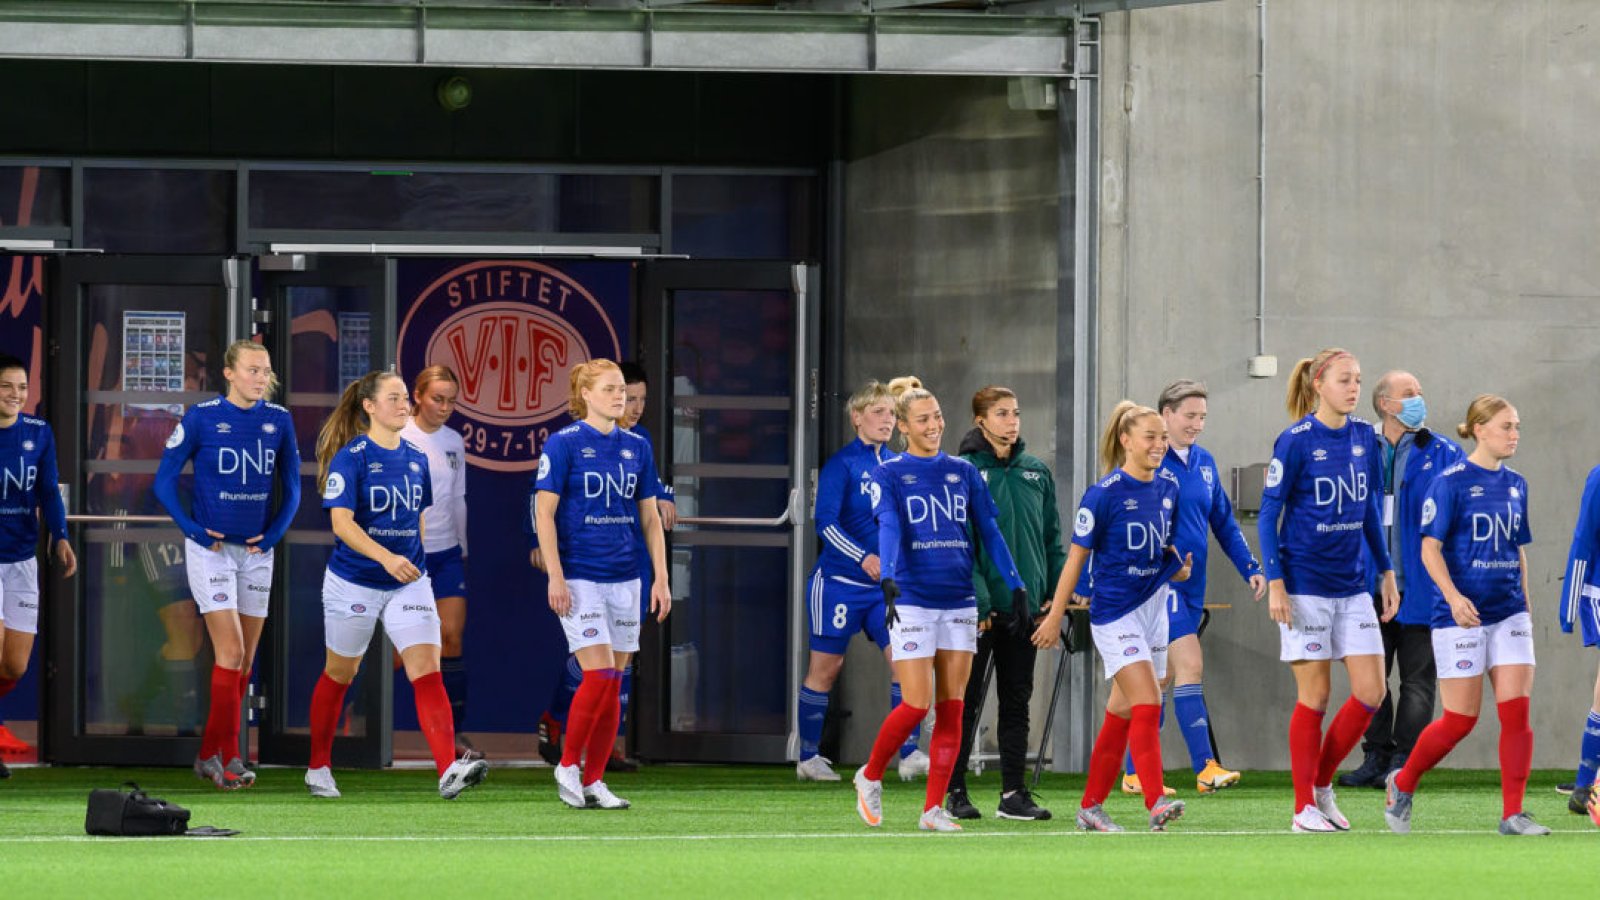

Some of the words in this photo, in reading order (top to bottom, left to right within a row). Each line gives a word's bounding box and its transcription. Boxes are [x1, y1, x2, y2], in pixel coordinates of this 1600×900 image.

[447, 270, 573, 313] STIFTET
[0, 455, 38, 500] NB
[218, 438, 276, 485] DNB
[369, 474, 423, 521] DNB
[584, 462, 638, 508] DNB
[906, 484, 967, 532] DNB
[1314, 462, 1369, 515] DNB
[832, 602, 848, 630] 8
